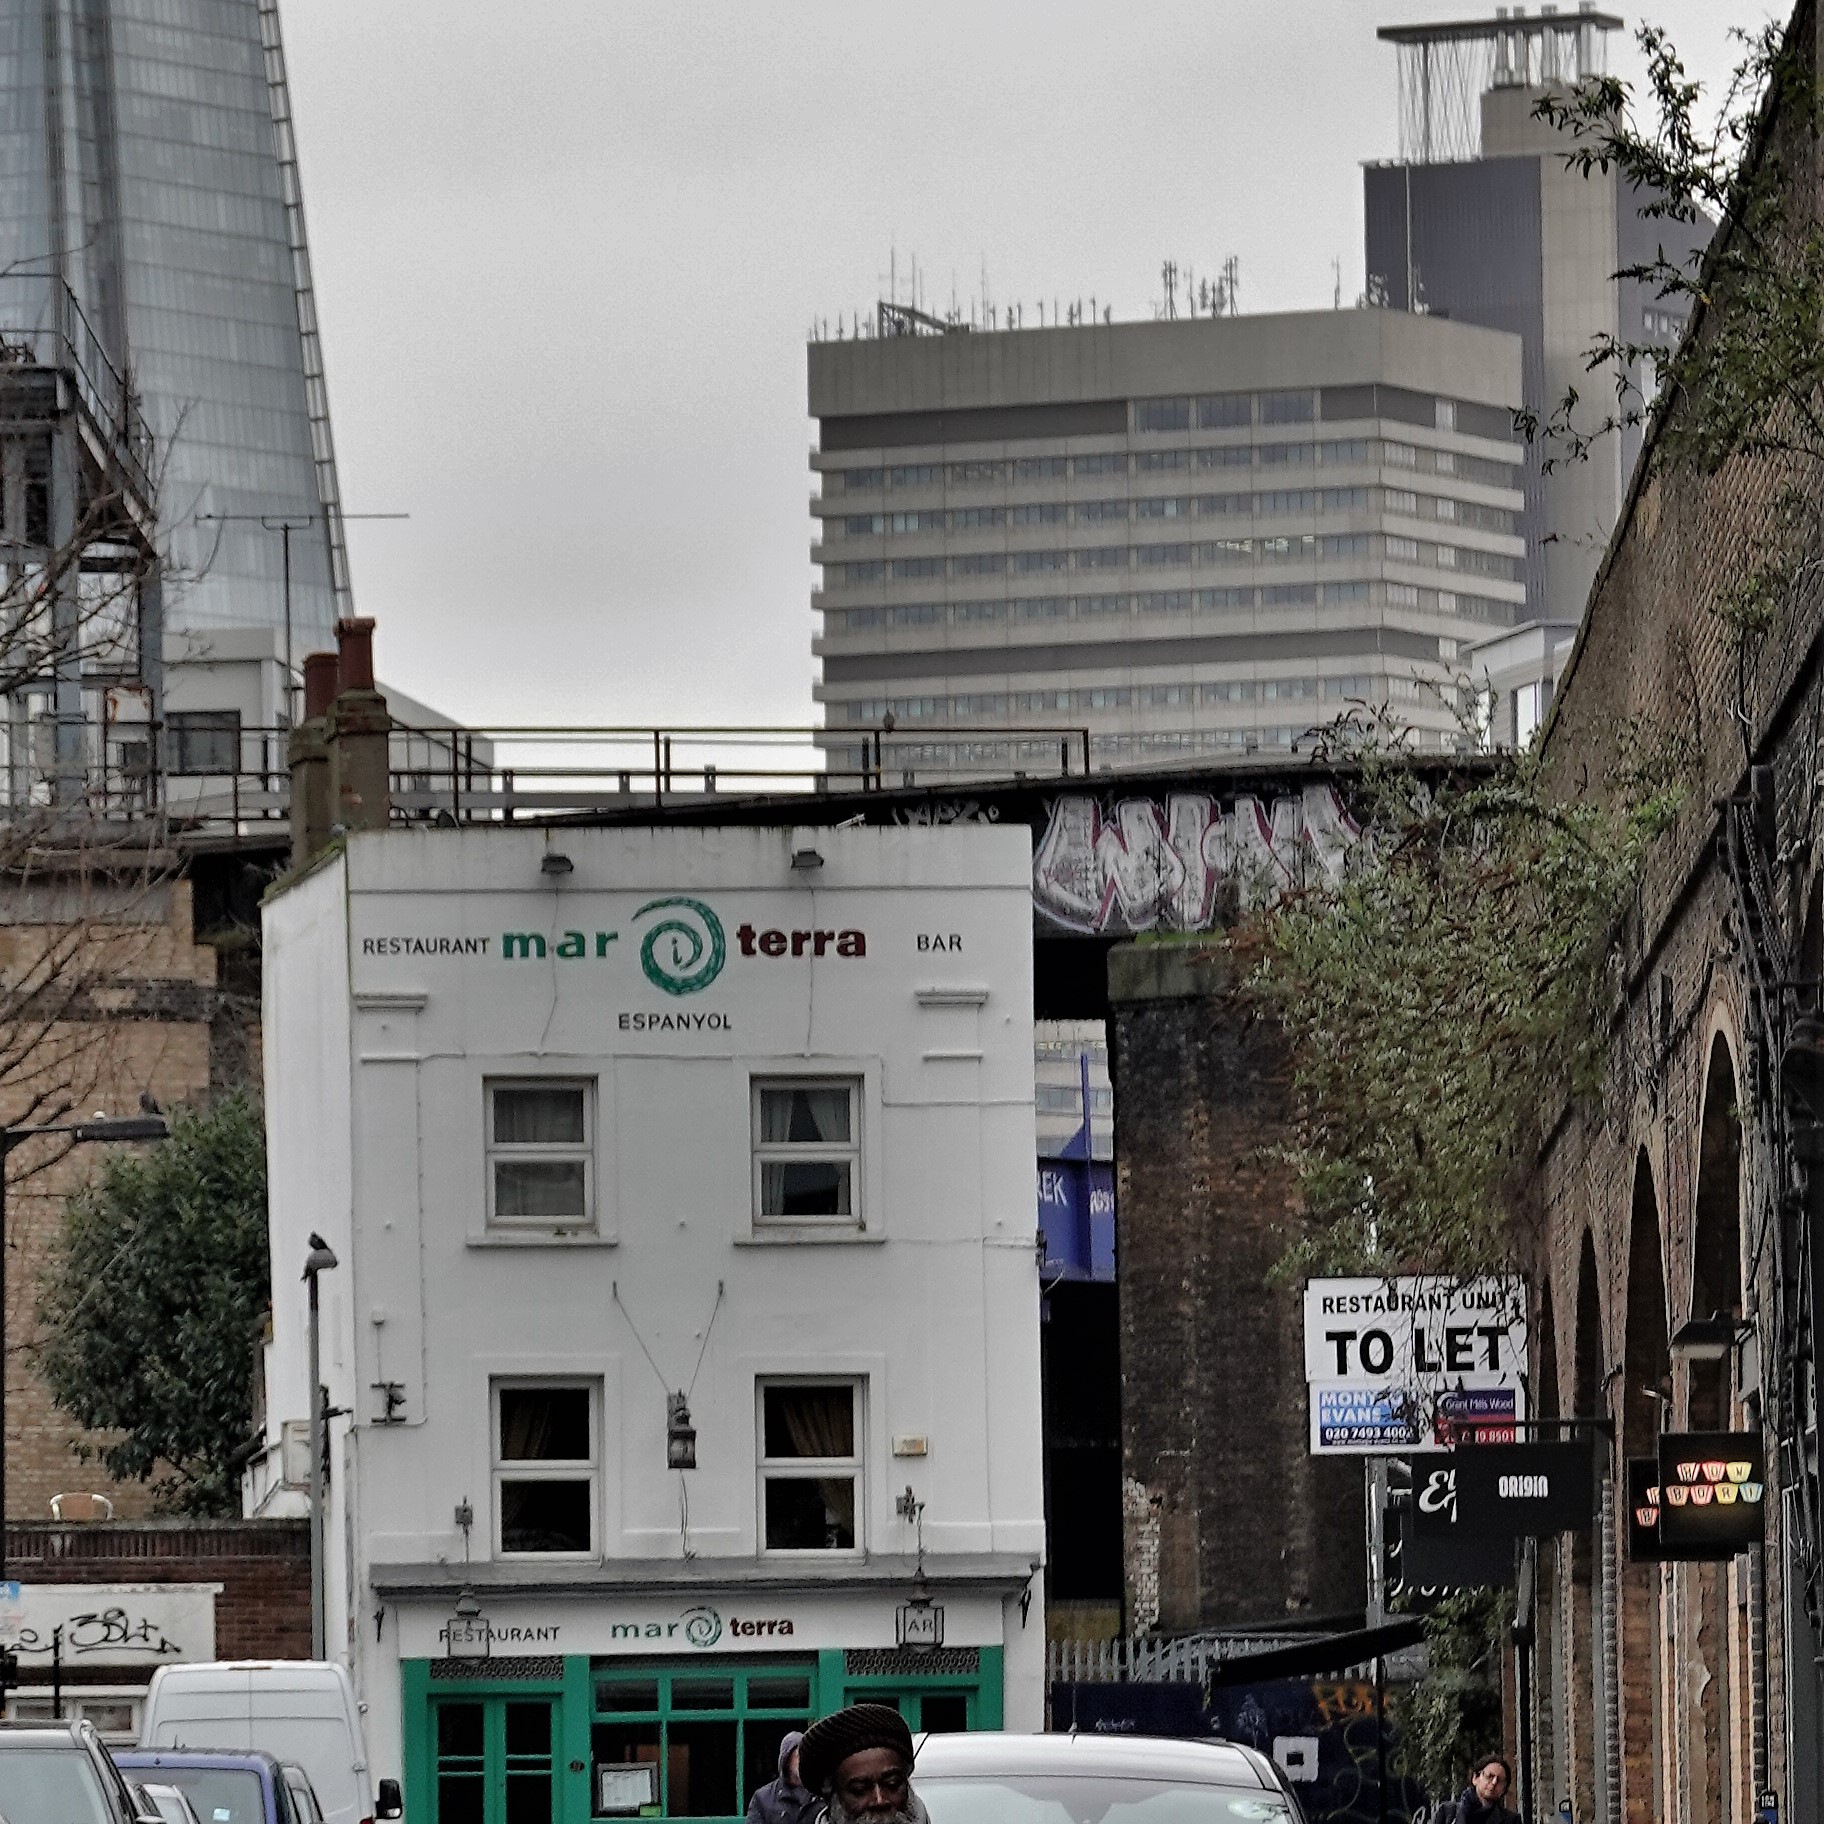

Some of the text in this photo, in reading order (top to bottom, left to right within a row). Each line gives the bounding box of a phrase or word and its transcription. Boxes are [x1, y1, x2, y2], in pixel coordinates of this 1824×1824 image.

[362, 937, 491, 956] RESTAURANT
[501, 930, 619, 959] mar
[736, 923, 868, 958] terra
[916, 933, 964, 953] BAR
[617, 1012, 733, 1031] ESPANYOL
[1322, 1292, 1455, 1315] RESTAURANT
[1325, 1325, 1510, 1376] TO LET
[1489, 1396, 1514, 1410] Wood
[1325, 1426, 1349, 1441] 020
[438, 1625, 561, 1643] RESTAURANT
[610, 1622, 679, 1639] mar
[729, 1616, 795, 1637] terra
